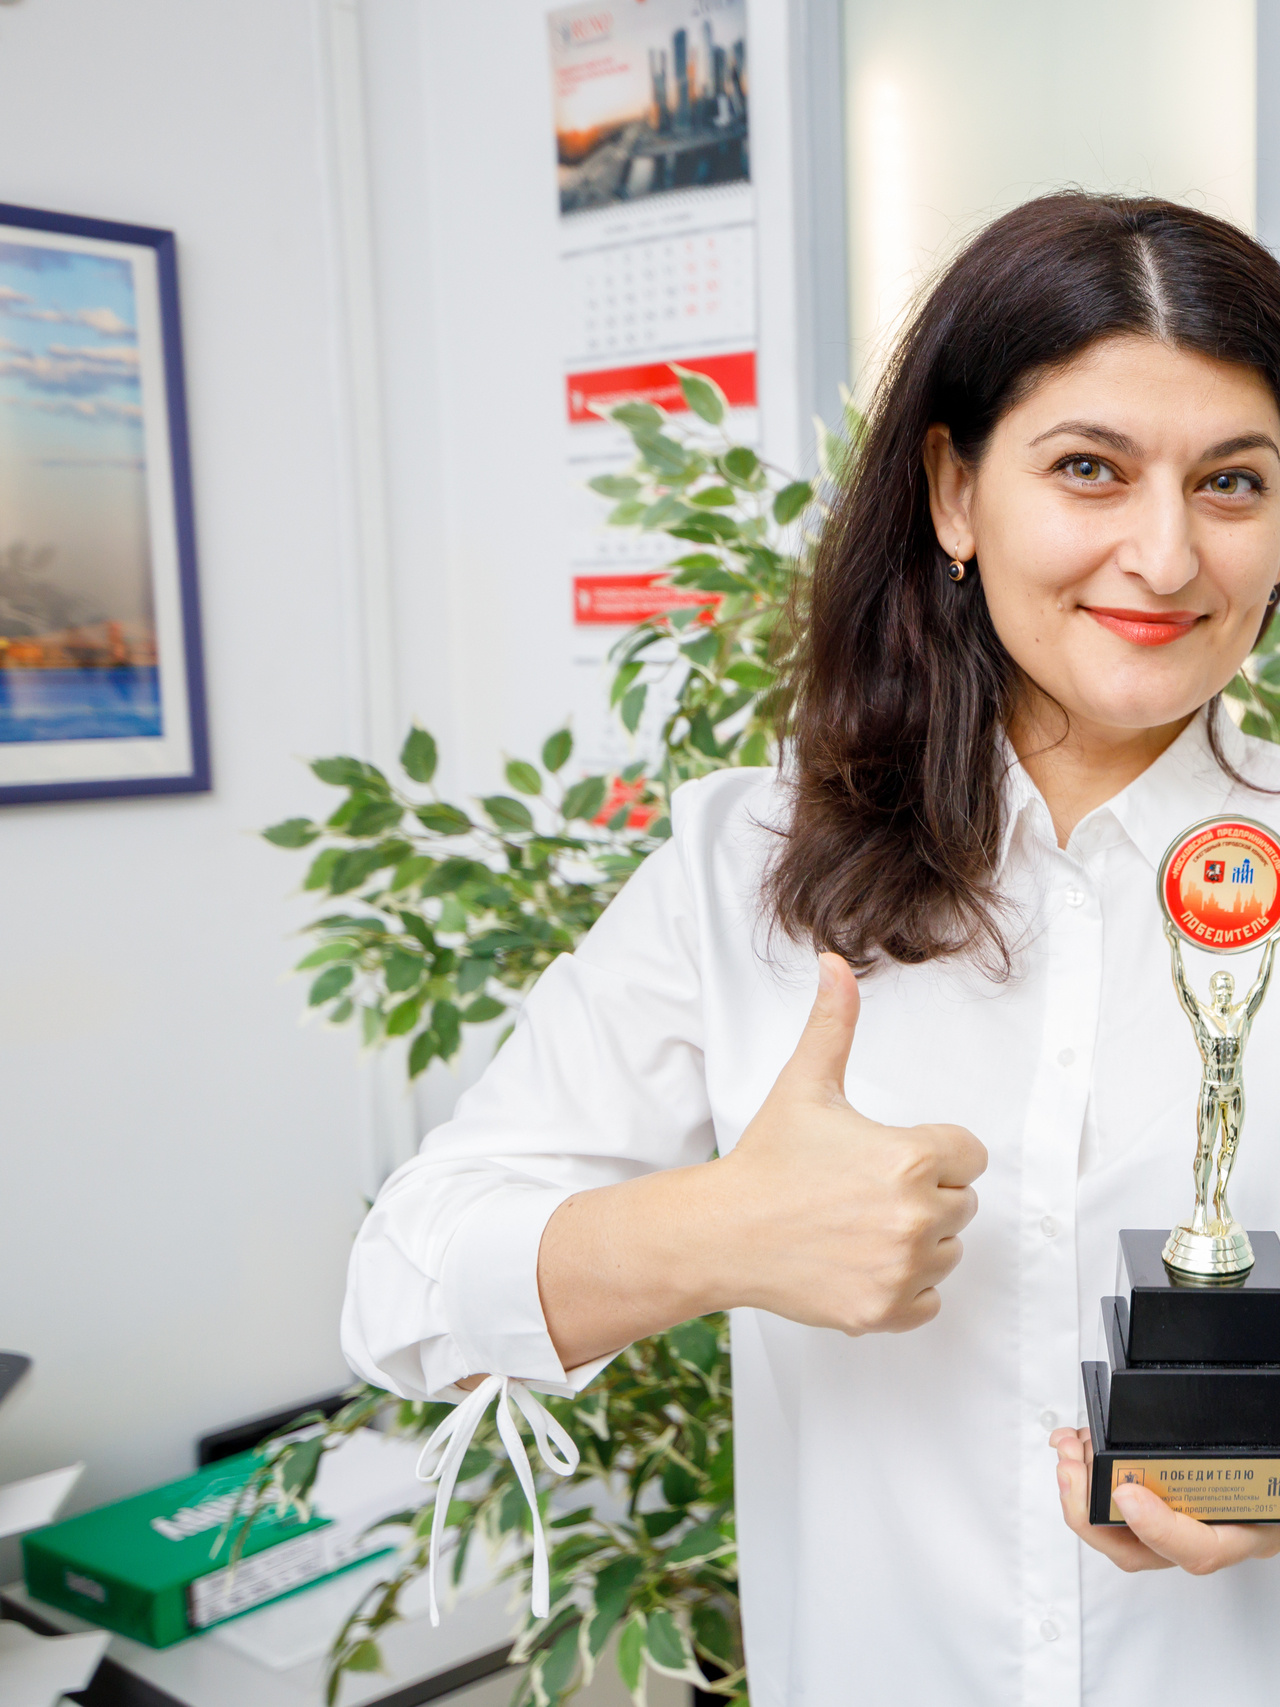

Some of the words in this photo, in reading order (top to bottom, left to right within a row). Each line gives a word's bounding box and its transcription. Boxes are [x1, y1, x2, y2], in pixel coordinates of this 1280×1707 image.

[1172, 831, 1214, 880] «МОСКОВСКИЙ
[1180, 910, 1270, 943] ПОБЕДИТЕЛЬ
[1160, 1469, 1255, 1482] ПОБЕДИТЕЛЮ
[1167, 1486, 1207, 1494] Ежегодного
[1208, 1486, 1245, 1494] городского
[1161, 1495, 1183, 1503] курса
[1184, 1494, 1232, 1502] Правительства
[1234, 1493, 1260, 1502] Москвы
